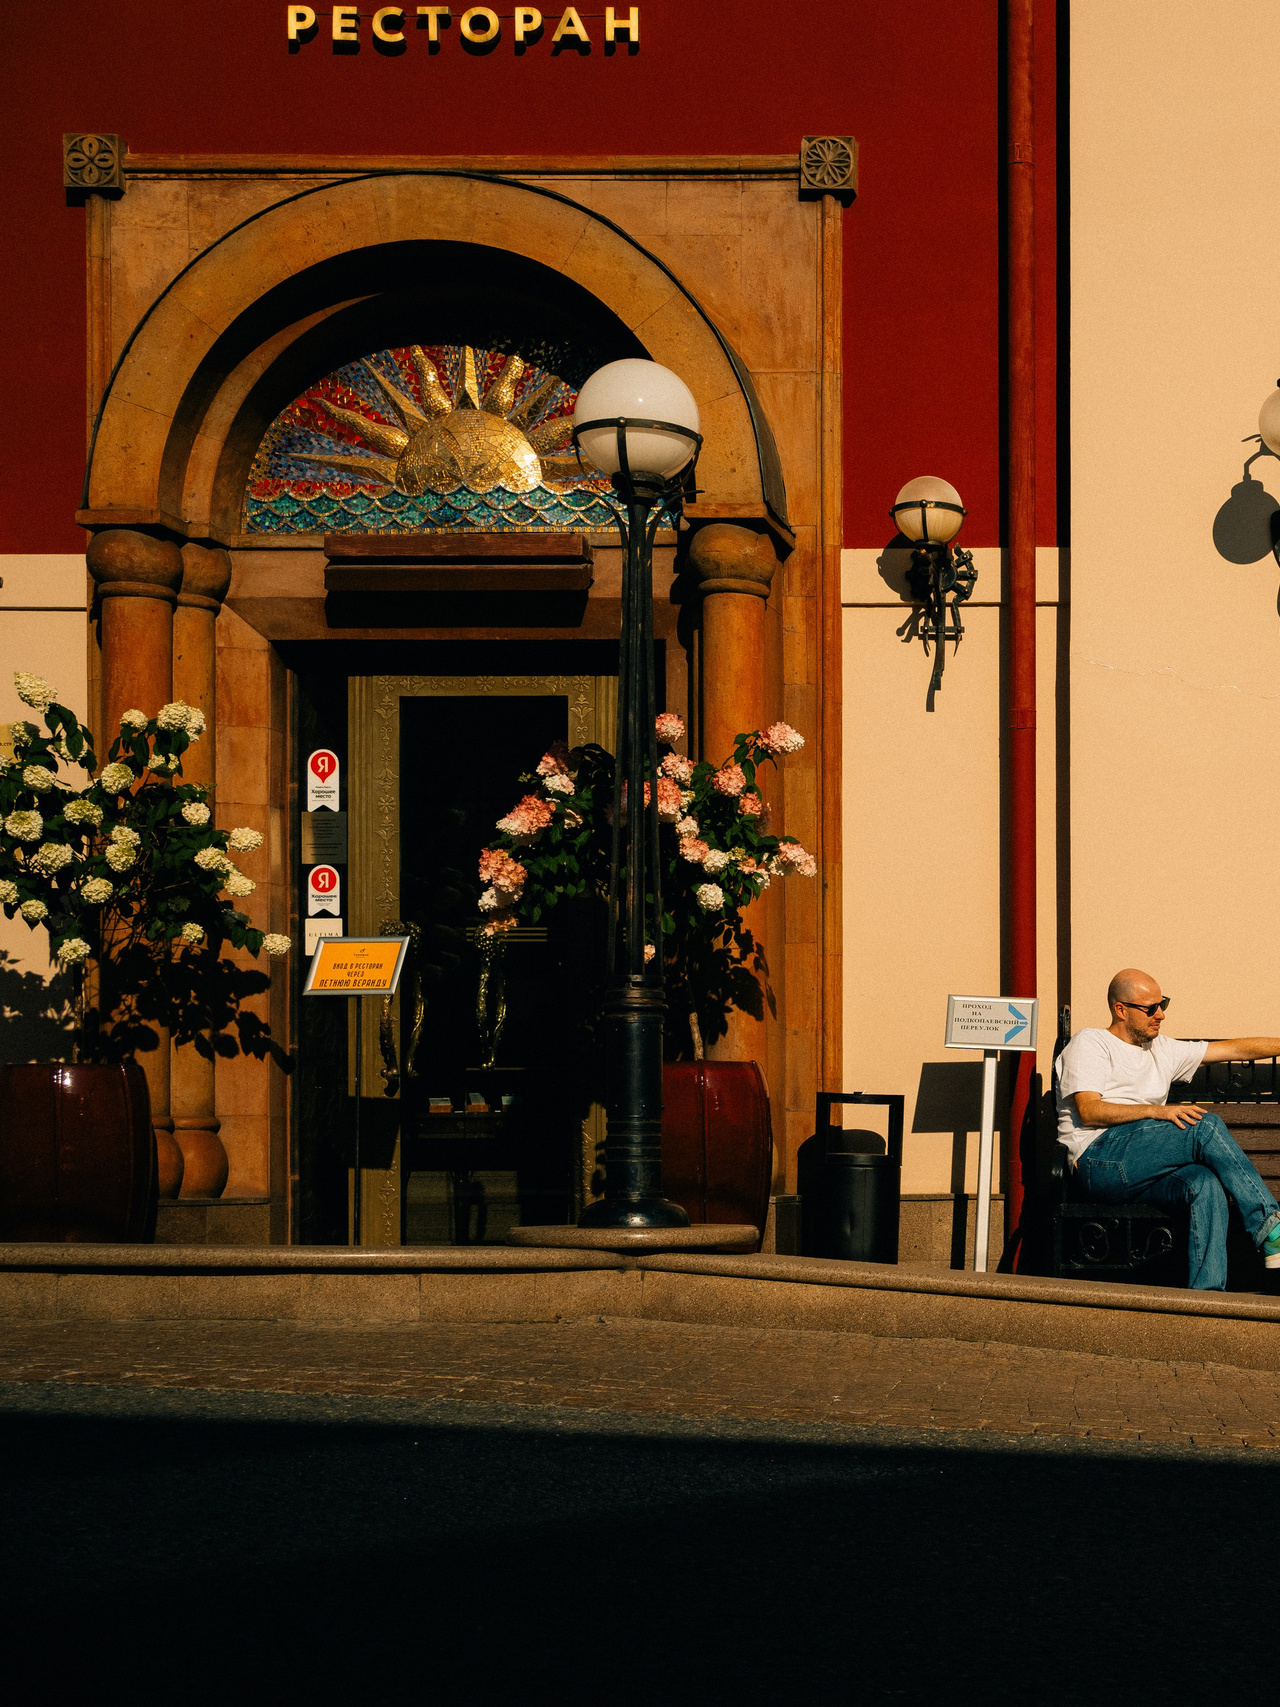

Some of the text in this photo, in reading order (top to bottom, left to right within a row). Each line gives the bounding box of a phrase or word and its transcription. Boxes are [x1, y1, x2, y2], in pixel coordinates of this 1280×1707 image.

[286, 5, 640, 43] РЕСТОРАН
[317, 756, 329, 773] Я
[318, 872, 329, 889] Я
[319, 979, 388, 988] ЛЕТНЮЮ ВЕРАНДУ
[954, 1017, 1019, 1025] ПОДКОПАЕВСКИЙ
